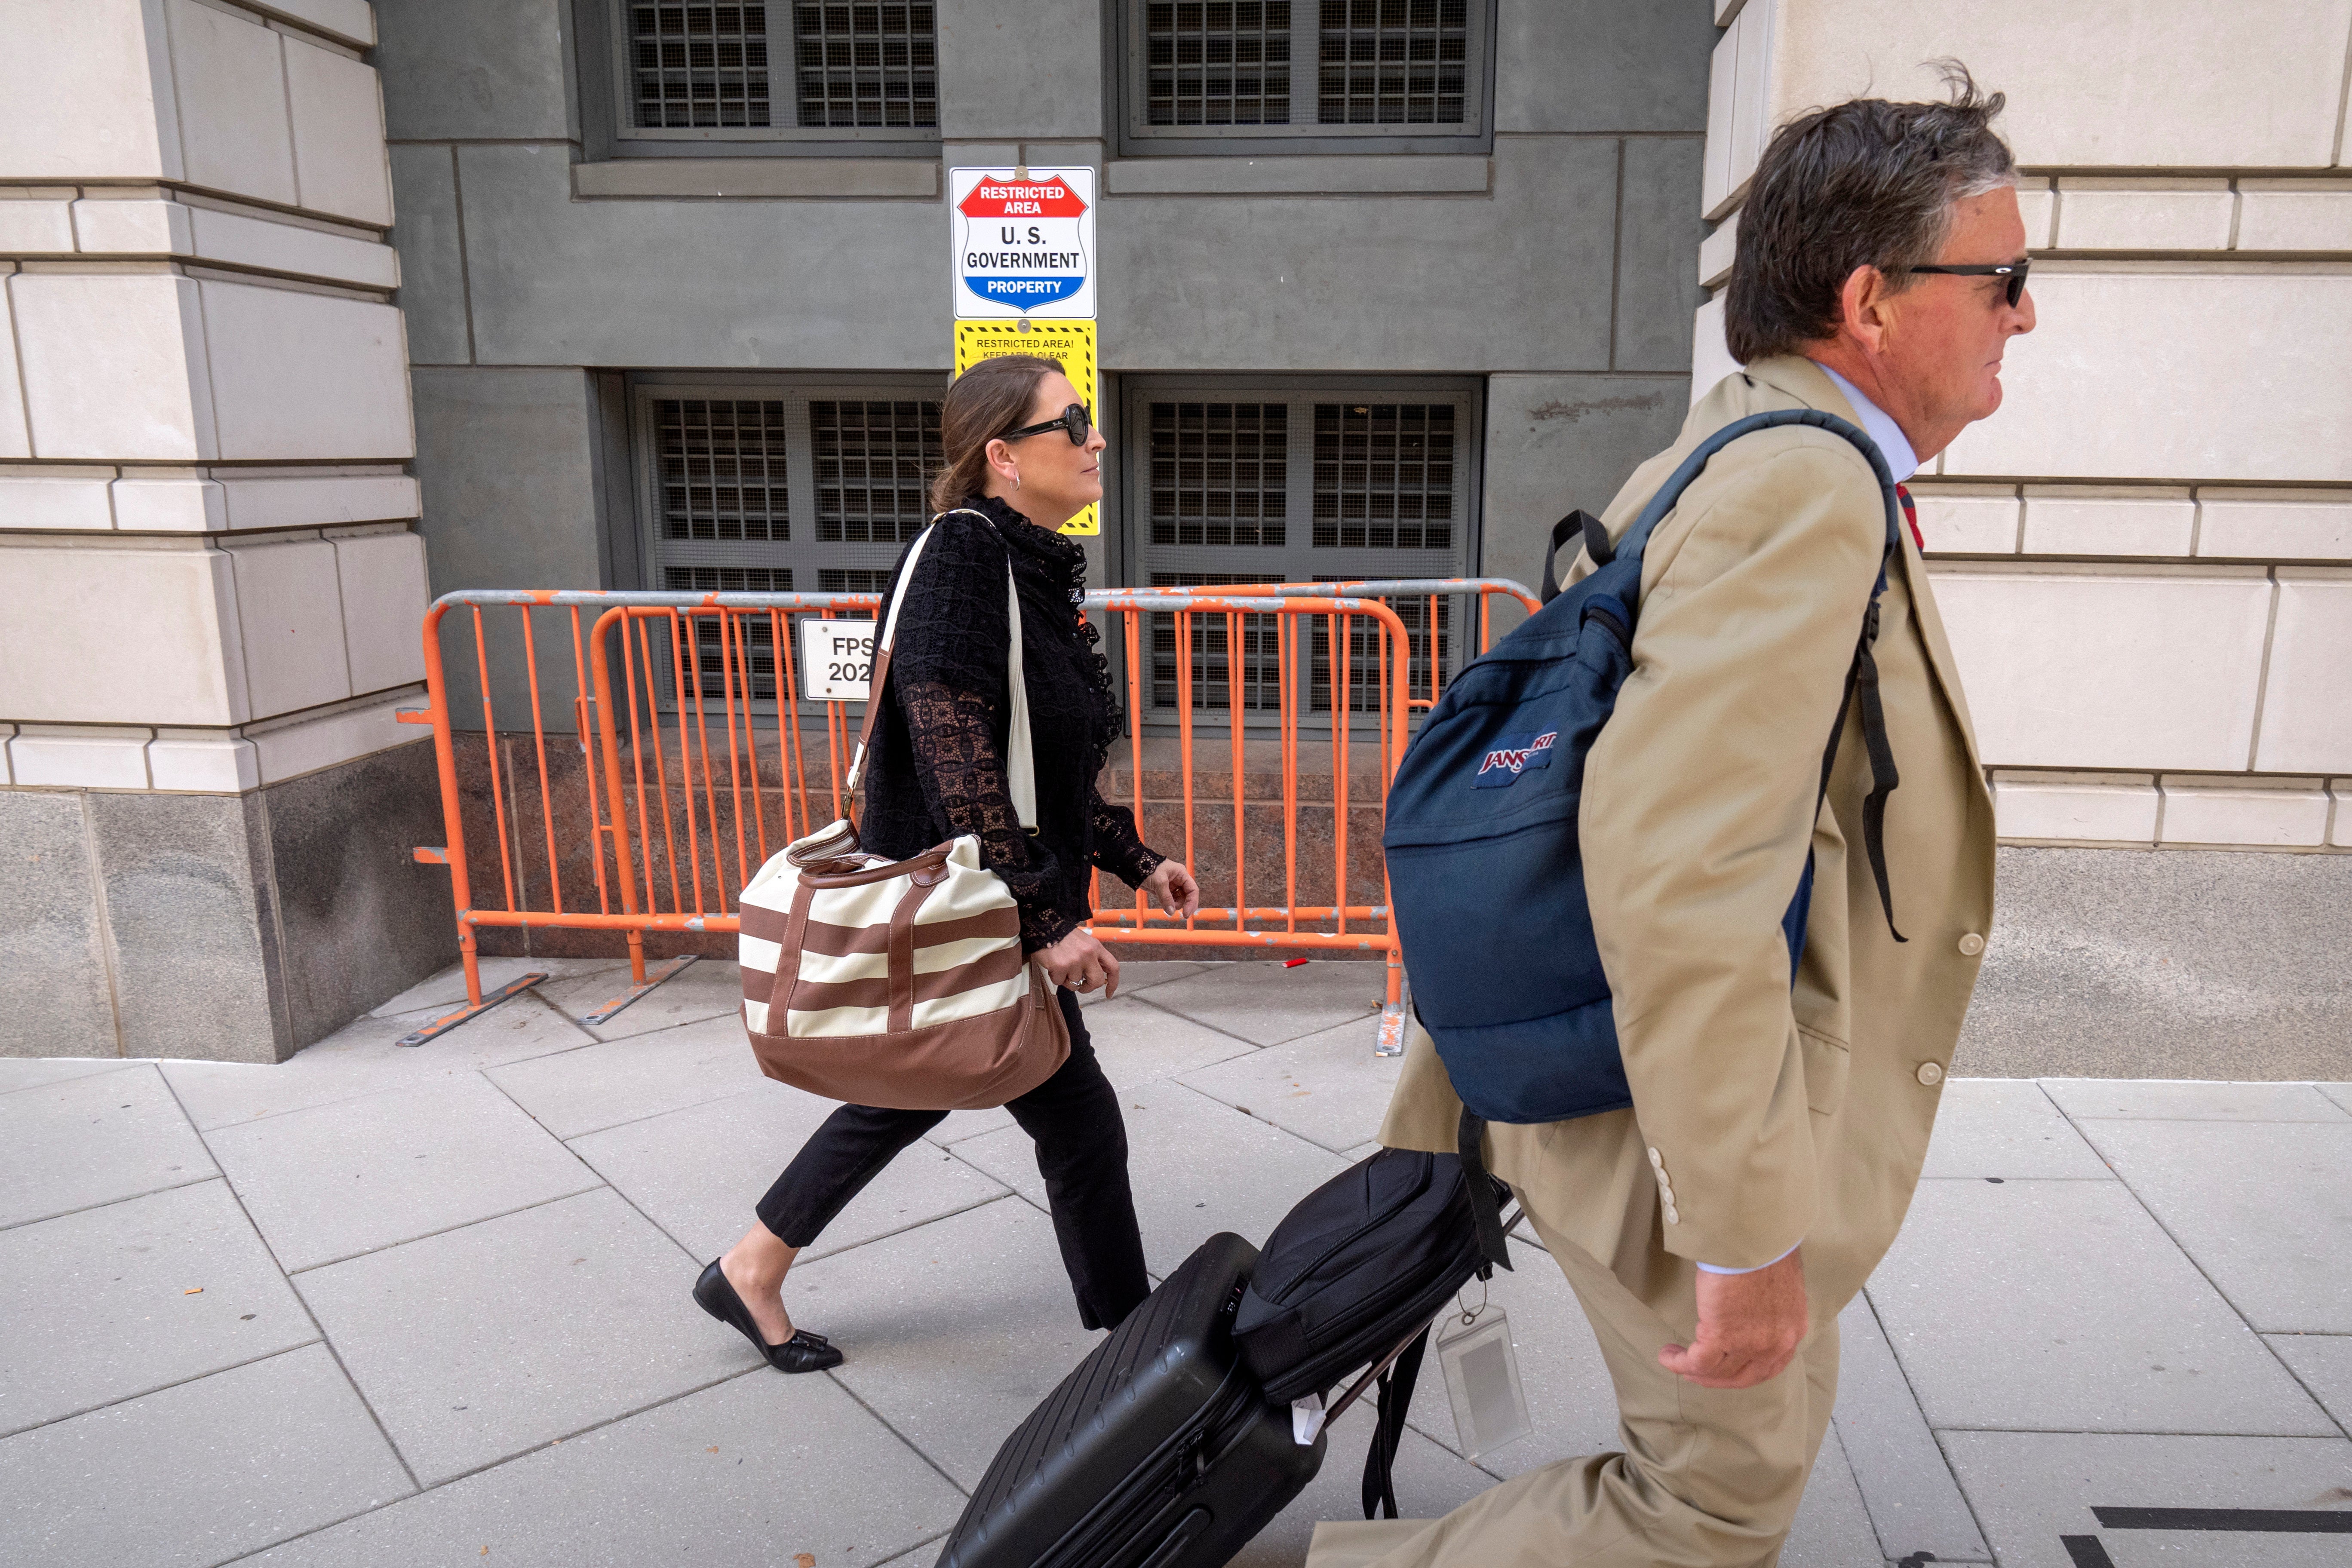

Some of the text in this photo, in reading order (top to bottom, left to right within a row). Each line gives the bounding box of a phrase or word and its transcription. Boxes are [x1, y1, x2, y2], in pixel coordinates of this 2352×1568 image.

[980, 187, 1065, 199] RESTRICTED
[1004, 202, 1041, 214] AREA
[1001, 227, 1046, 245] U. S.
[967, 252, 1079, 268] GOVERNMENT
[988, 281, 1062, 293] PROPERTY
[977, 340, 1040, 348] RESTRICTED
[833, 638, 874, 657] FPS
[1477, 732, 1557, 775] JANSRT
